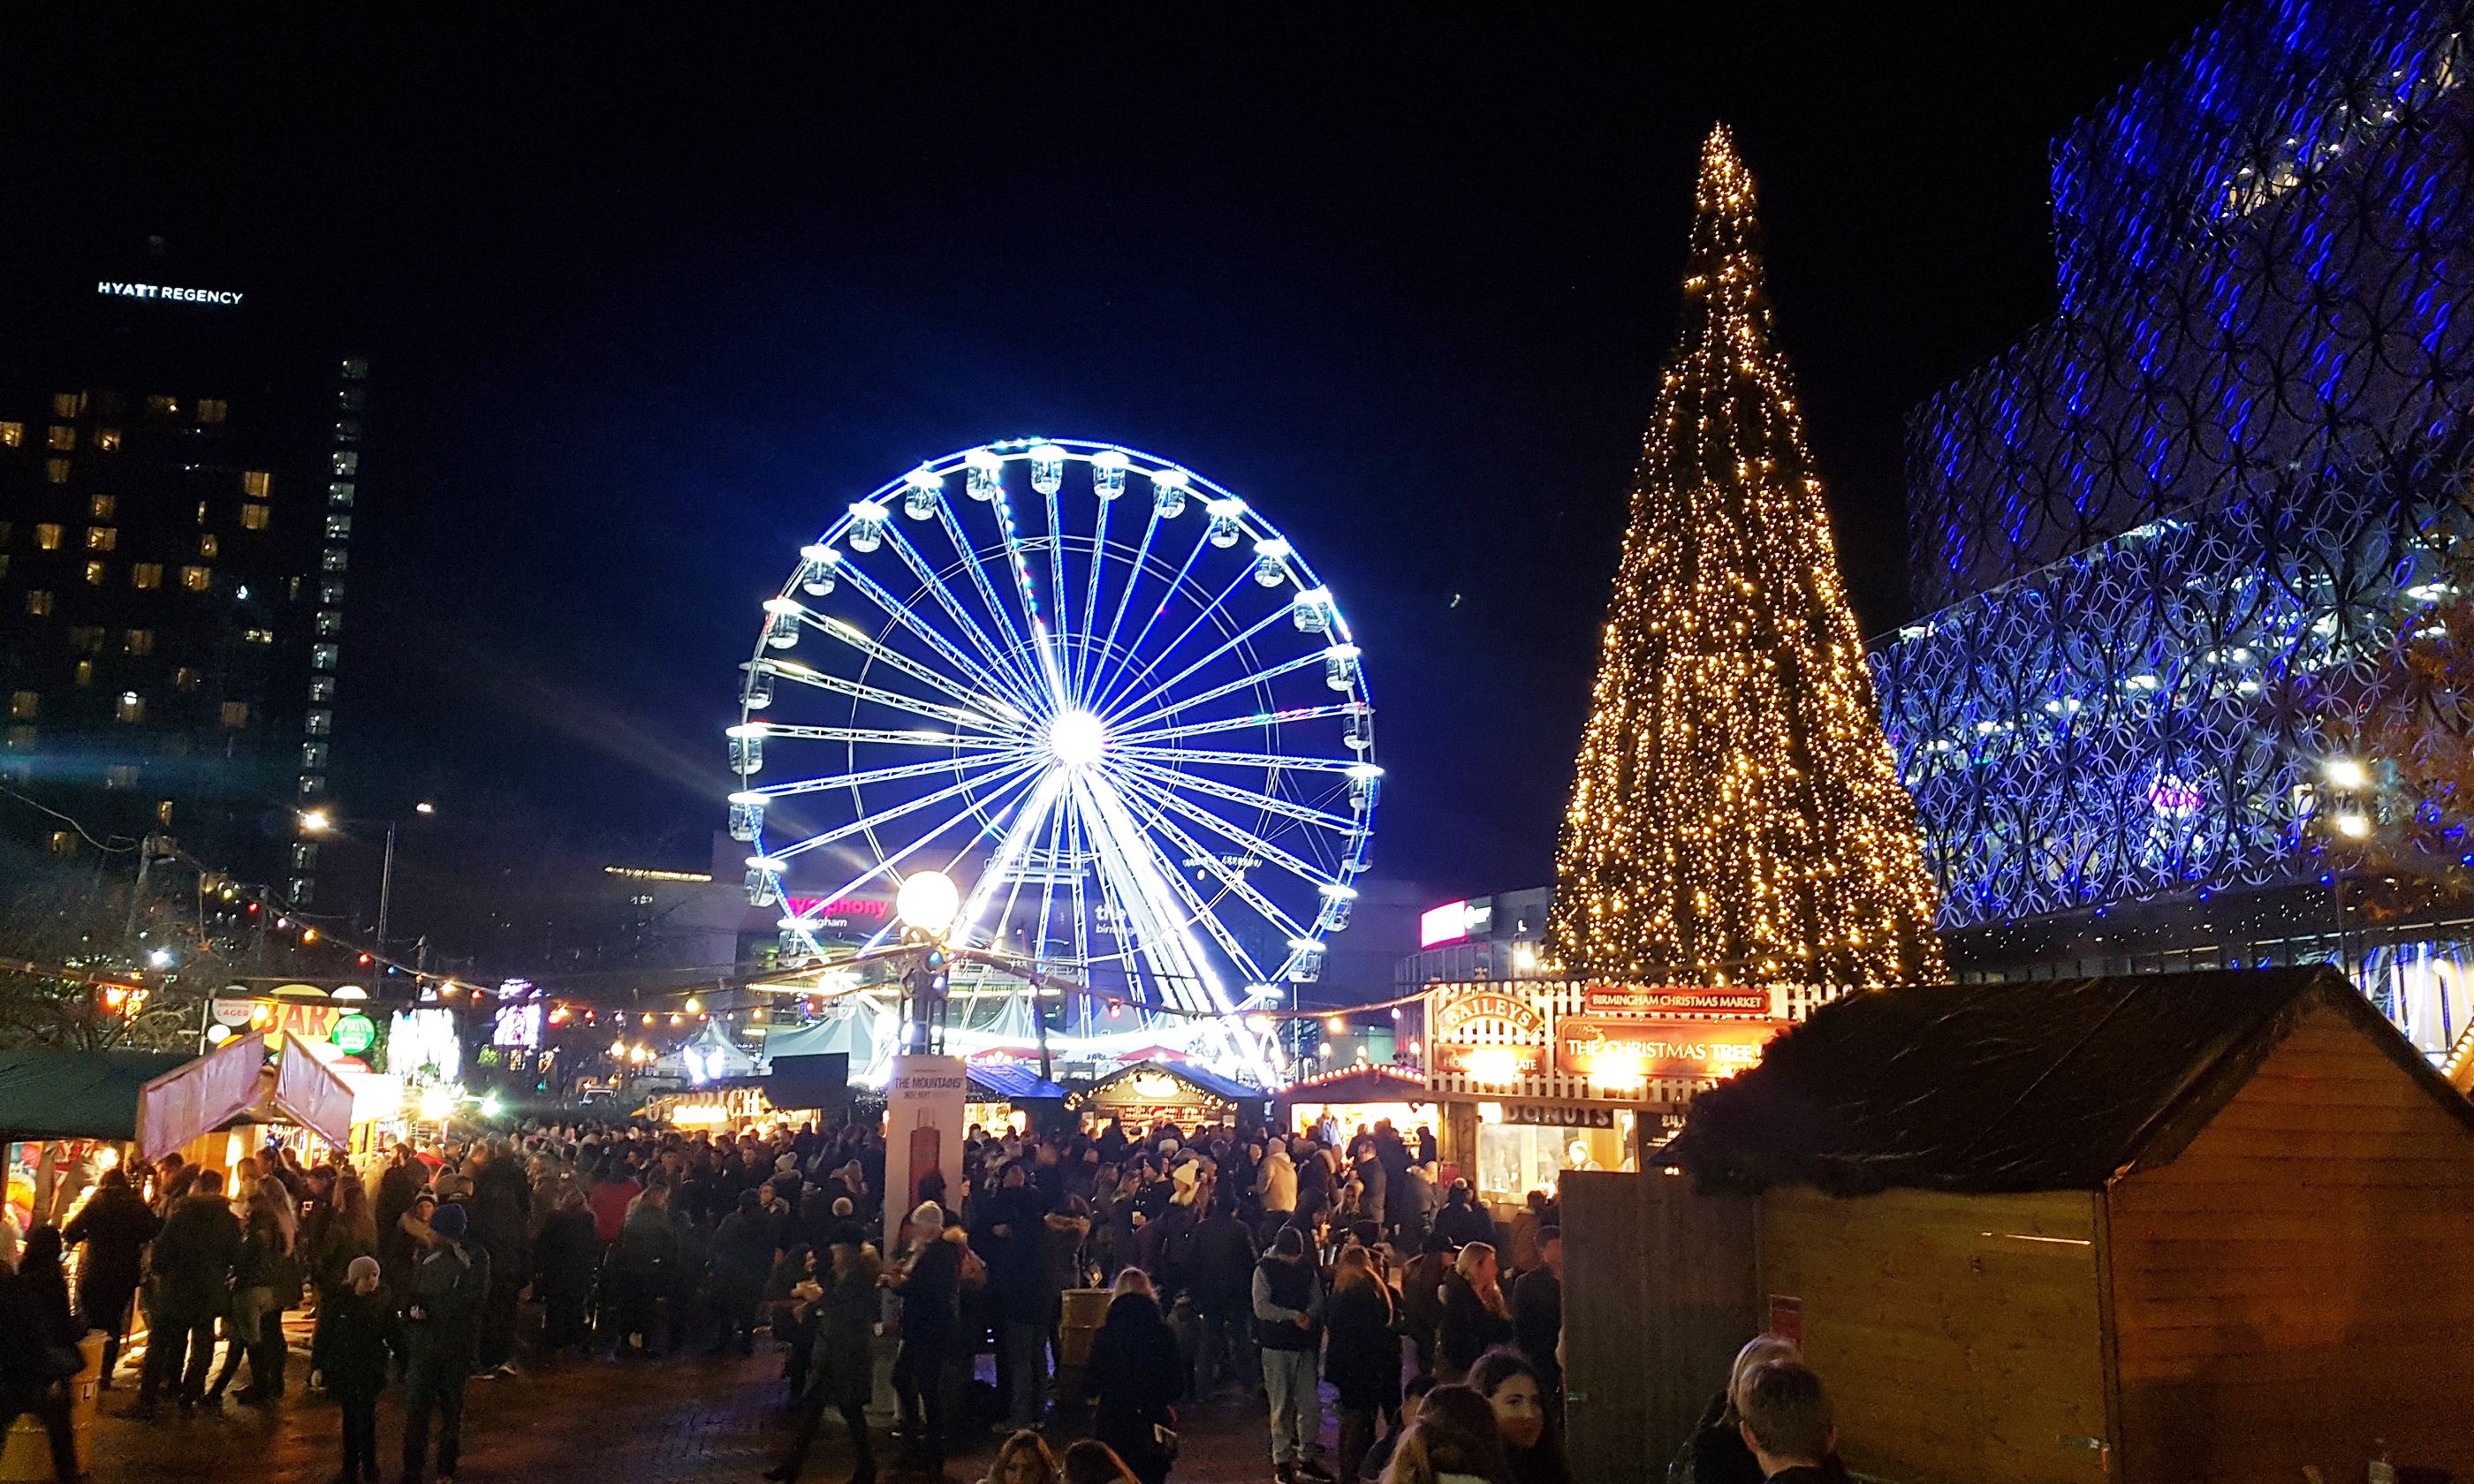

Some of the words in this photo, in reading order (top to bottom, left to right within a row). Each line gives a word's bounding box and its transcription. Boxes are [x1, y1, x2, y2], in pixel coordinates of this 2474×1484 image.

[98, 282, 157, 297] HYATT
[161, 286, 242, 304] REGENCY
[1444, 998, 1533, 1027] BAILEYS
[1592, 995, 1658, 1006] BIRMINGHAM
[1660, 996, 1719, 1007] CHRISTMAS
[1719, 996, 1761, 1008] MARKET
[263, 1003, 329, 1035] BAR
[1567, 1039, 1600, 1056] THE
[1602, 1040, 1706, 1061] CHRISTMAS
[1709, 1043, 1755, 1063] TREE
[1444, 1057, 1465, 1069] HO
[1507, 1105, 1609, 1126] DONUTS
